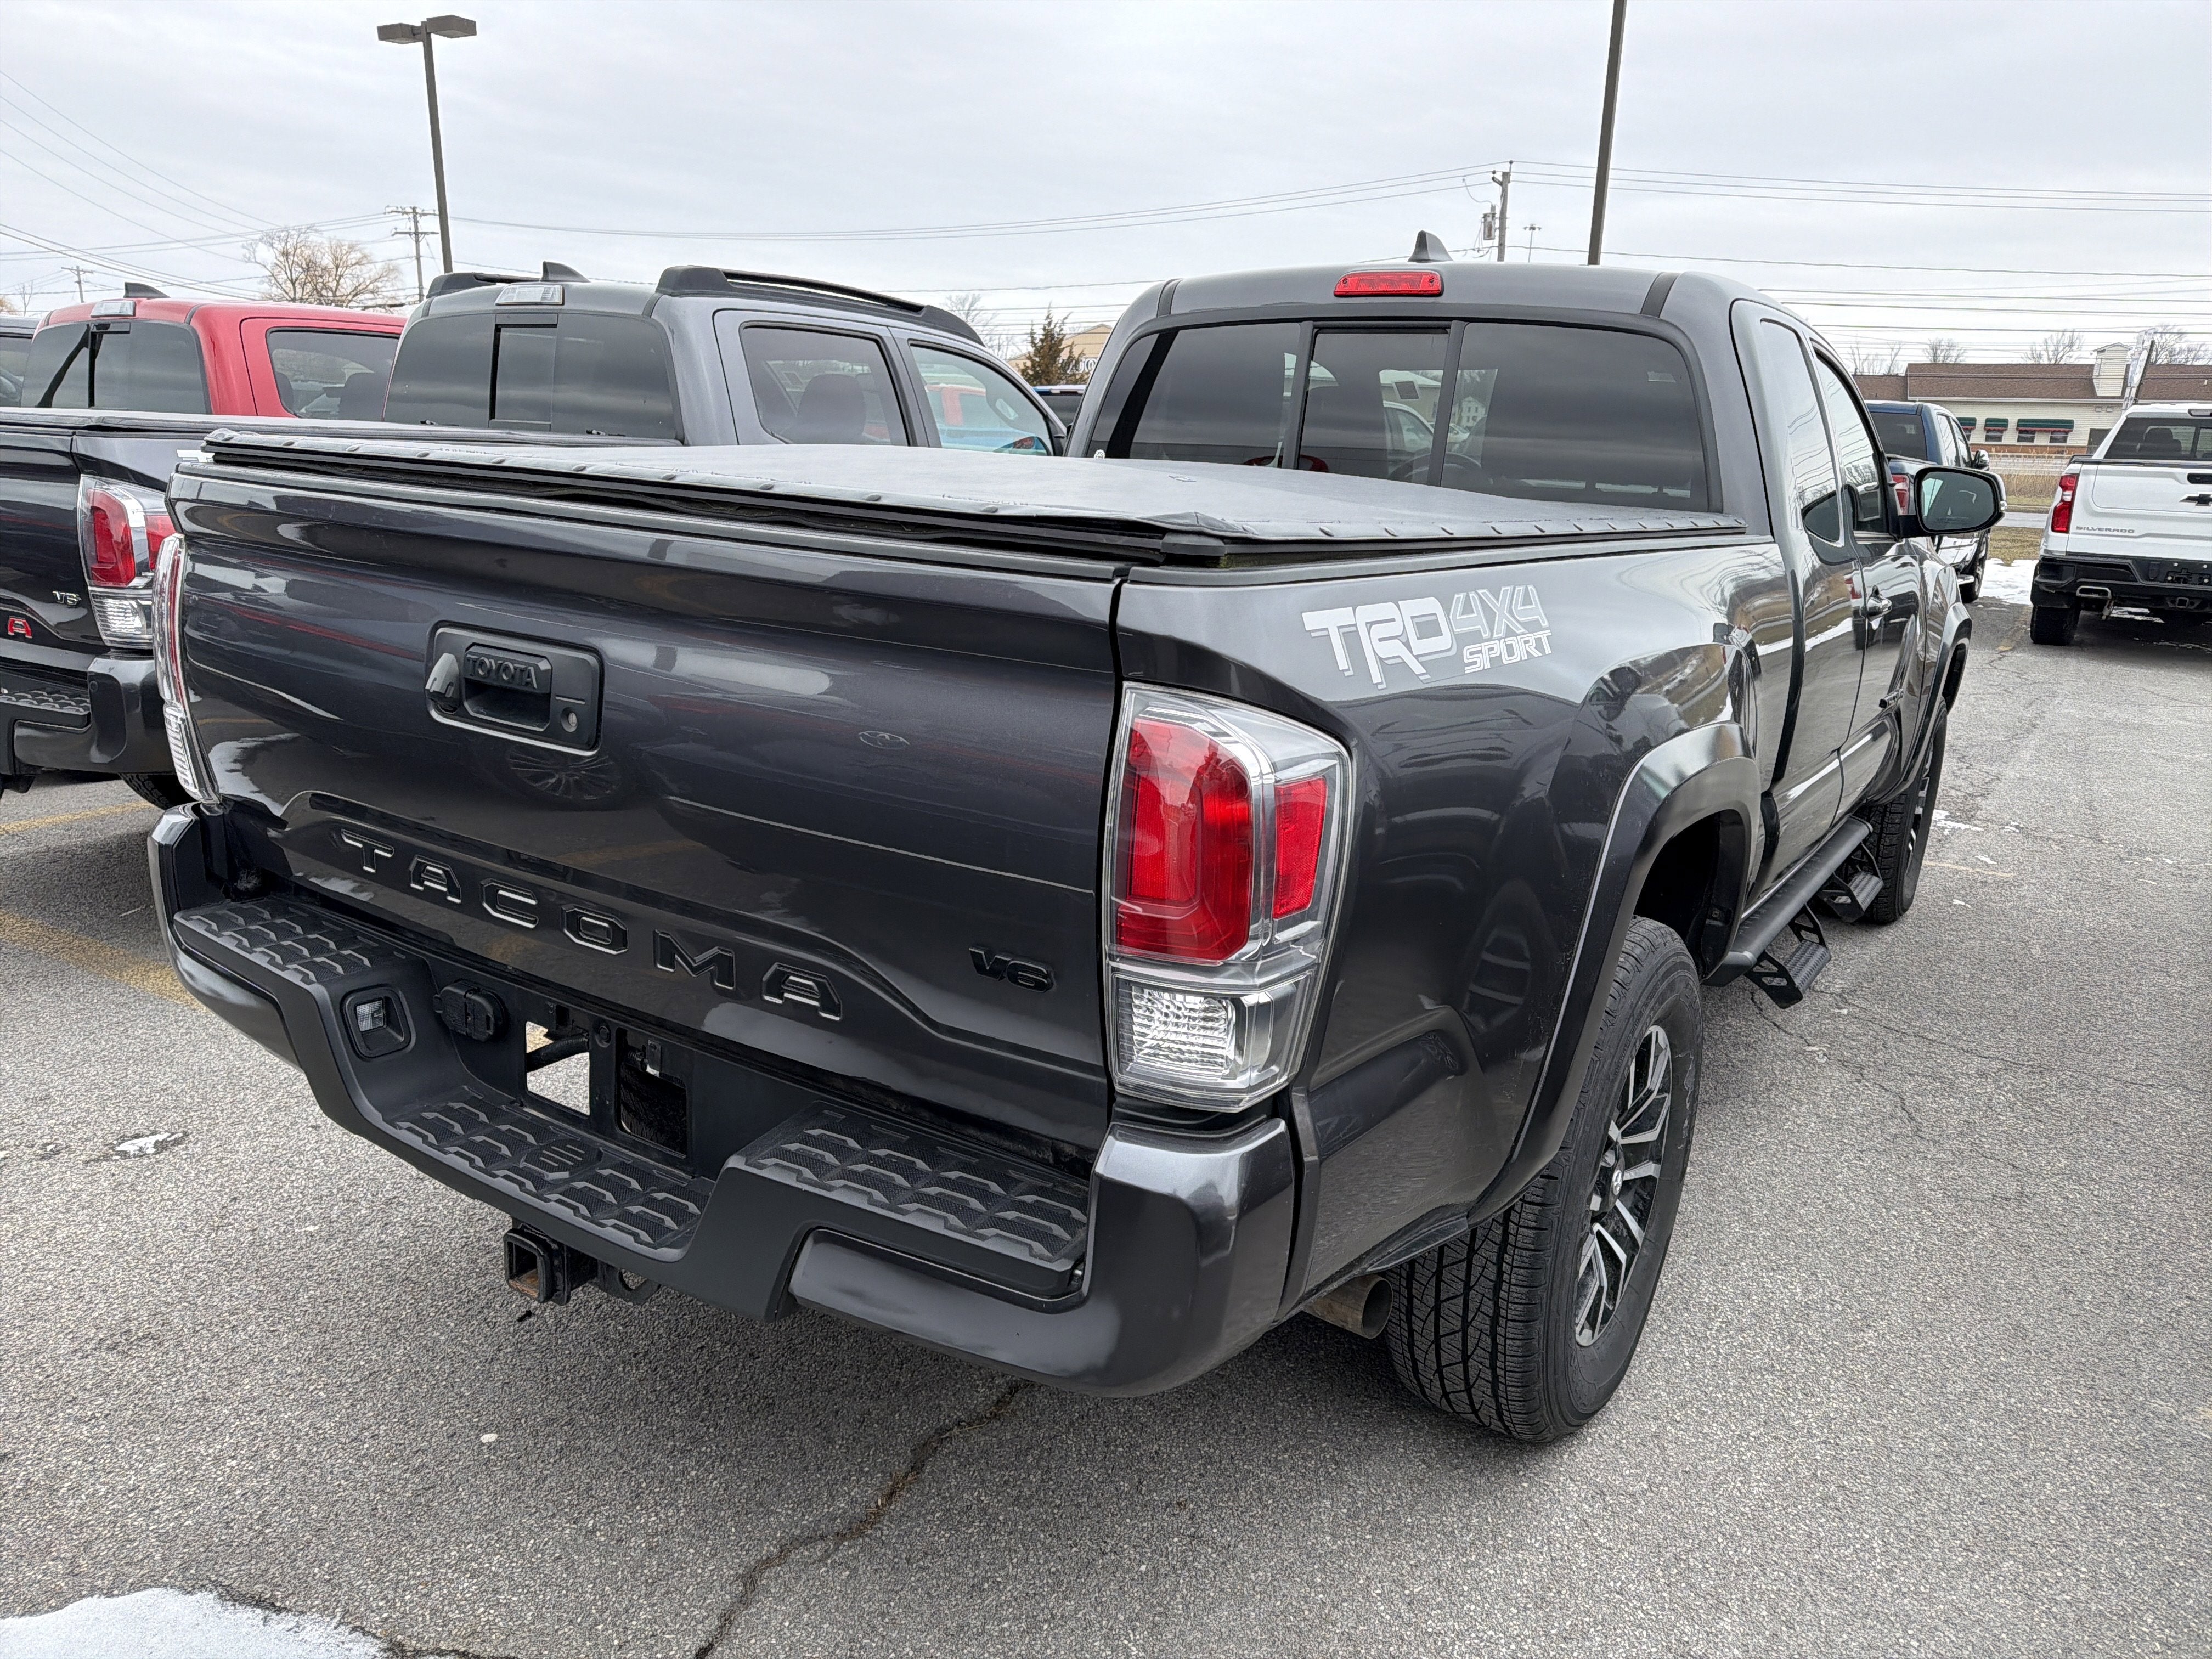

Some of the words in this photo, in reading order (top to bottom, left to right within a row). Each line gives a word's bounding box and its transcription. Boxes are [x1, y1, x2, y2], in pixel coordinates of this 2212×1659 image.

[2075, 526, 2135, 534] SILVERADO
[1301, 597, 1457, 689] TRD
[1463, 629, 1552, 674] SPORT
[466, 654, 538, 690] TOYOTA
[341, 829, 843, 1022] TACOMA
[968, 946, 1056, 994] V6
